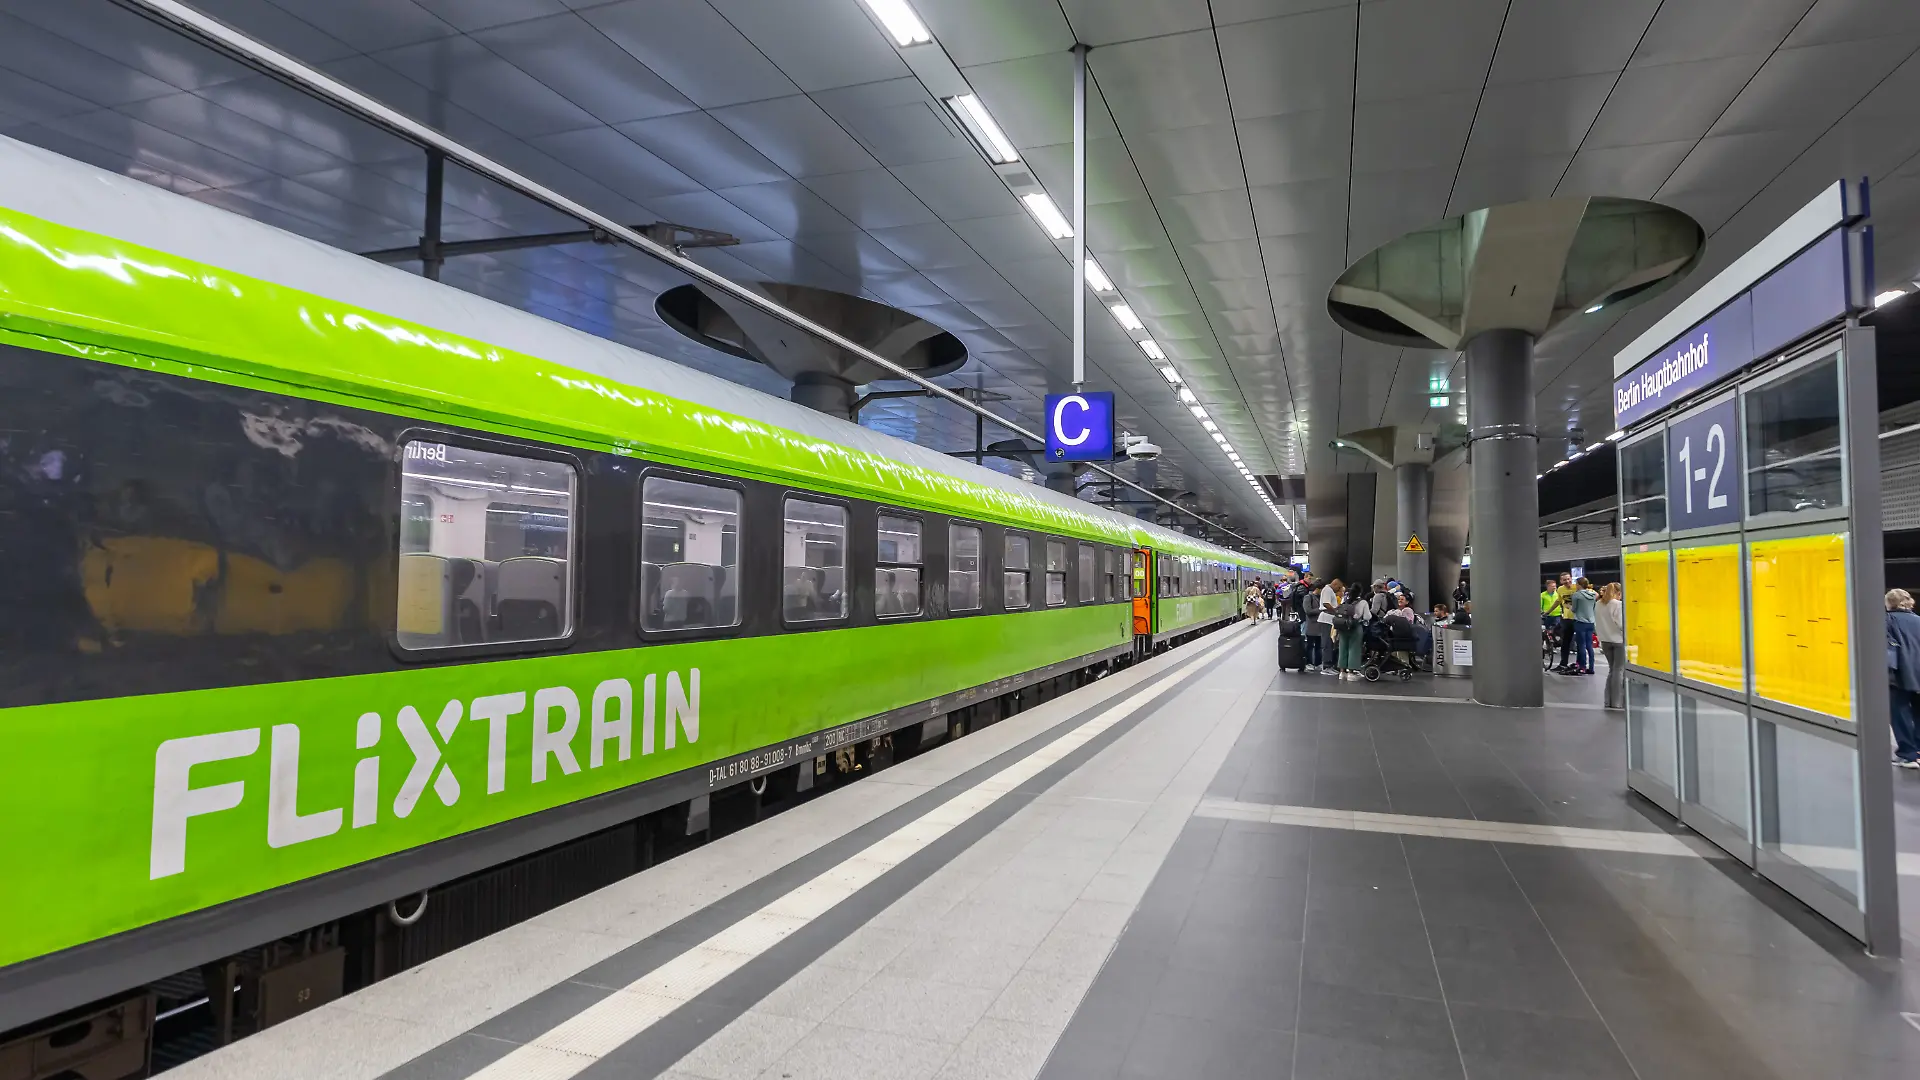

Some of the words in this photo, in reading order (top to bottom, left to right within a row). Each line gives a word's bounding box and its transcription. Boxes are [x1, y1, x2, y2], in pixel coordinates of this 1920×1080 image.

[1617, 380, 1640, 414] Berlin
[1641, 333, 1709, 401] Hauptbahnhof
[1053, 395, 1091, 446] C
[1679, 423, 1728, 514] 1-2
[1436, 639, 1445, 667] Abfall
[709, 765, 727, 786] D-TAL
[729, 762, 738, 777] 61
[739, 759, 749, 774] 80
